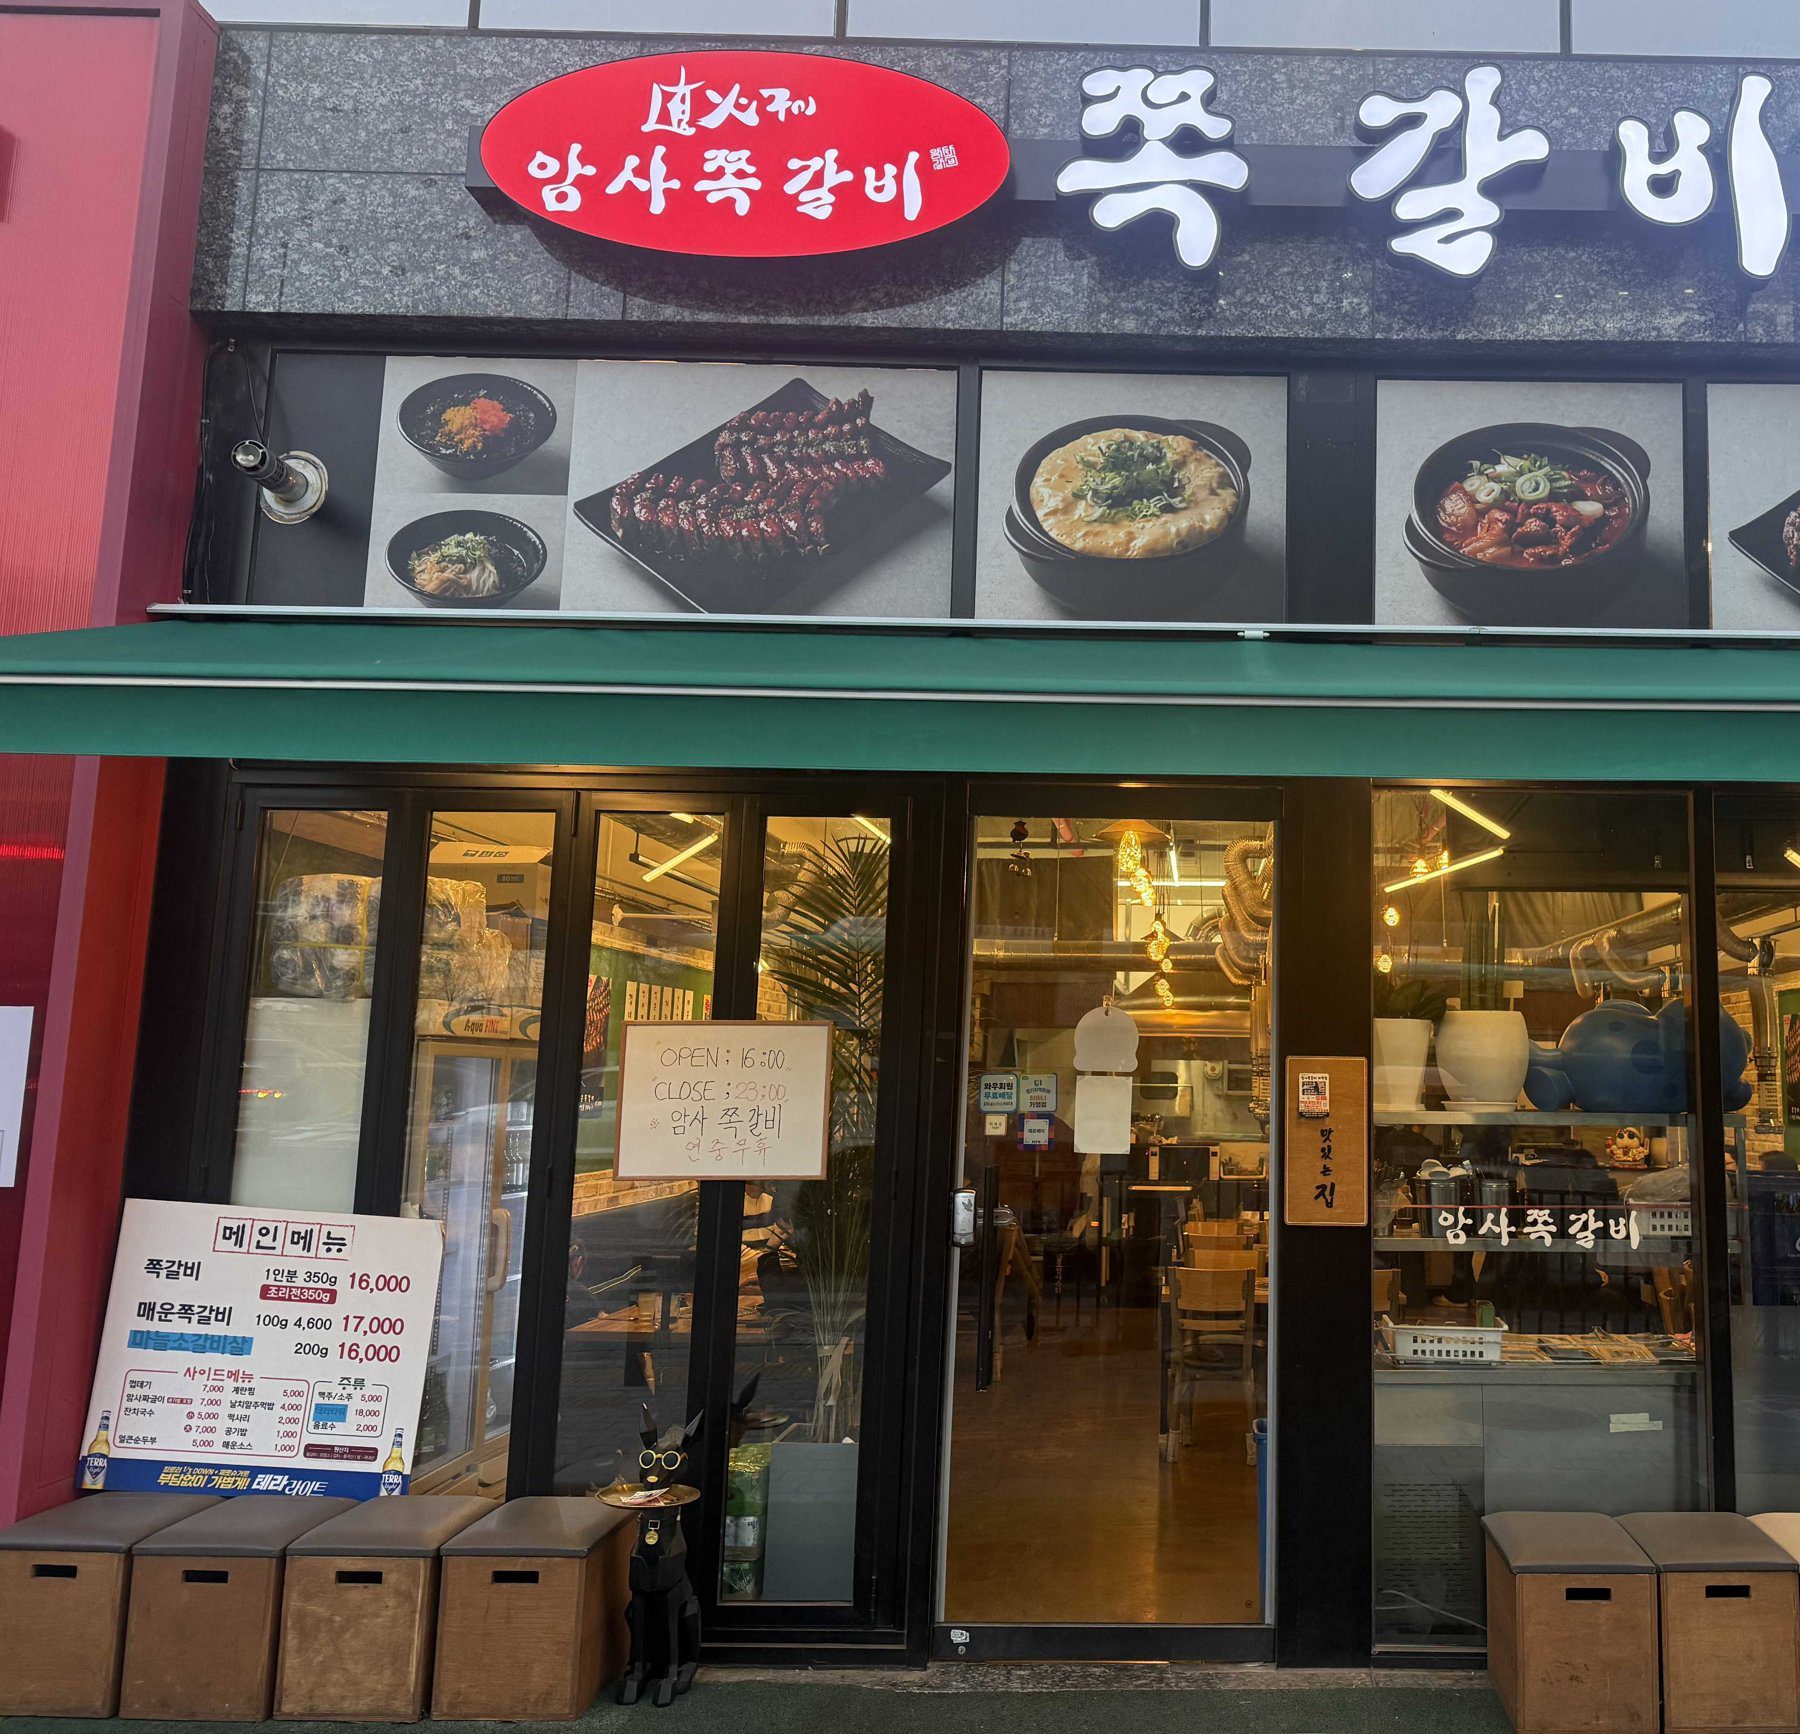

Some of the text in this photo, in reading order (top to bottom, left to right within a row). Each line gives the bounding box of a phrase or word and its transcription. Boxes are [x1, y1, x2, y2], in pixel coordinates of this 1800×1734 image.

[1056, 64, 1790, 279] 쪽갈비
[527, 142, 923, 221] 암사쪽갈비
[464, 1018, 484, 1034] Aqua
[984, 1082, 1013, 1091] 와우회원
[984, 1091, 1013, 1100] 무료배달
[1438, 1206, 1641, 1250] 암사쪽갈비
[221, 1223, 348, 1254] 메인메뉴
[144, 1258, 411, 1294] 쪽갈비 1인분 350g 16,000
[266, 1286, 331, 1303] 조리전350g
[136, 1301, 405, 1337] 매운쪽갈비 100g 4,600 17,000
[294, 1342, 329, 1358] 200g
[338, 1342, 401, 1364] 16,000
[183, 1366, 254, 1383] 사이드메뉴
[128, 1380, 304, 1398] 껍데기 7,000 계란찜 5,000
[337, 1377, 366, 1390] 주류
[200, 1398, 222, 1407] 7,000
[229, 1399, 275, 1411] 날치알주먹밥
[279, 1403, 302, 1412] 4,000
[318, 1391, 383, 1403] 맥주/소주 5,000
[123, 1407, 155, 1417] 잔치국수
[197, 1412, 219, 1421] 5,000
[227, 1413, 250, 1423] 떡사리
[277, 1416, 300, 1425] 2,000
[354, 1408, 380, 1418] 18,000
[195, 1425, 217, 1434] 7,000
[224, 1427, 248, 1437] 공기밥
[276, 1430, 298, 1439] 1,000
[313, 1421, 378, 1433] 음료수 2,000
[192, 1439, 214, 1448] 5,000
[221, 1440, 253, 1450] 매운소스
[274, 1443, 295, 1453] 1,000
[86, 1456, 108, 1468] TERRA
[157, 1472, 251, 1490] 부담없이 가볍게!
[381, 1473, 402, 1484] TERRA
